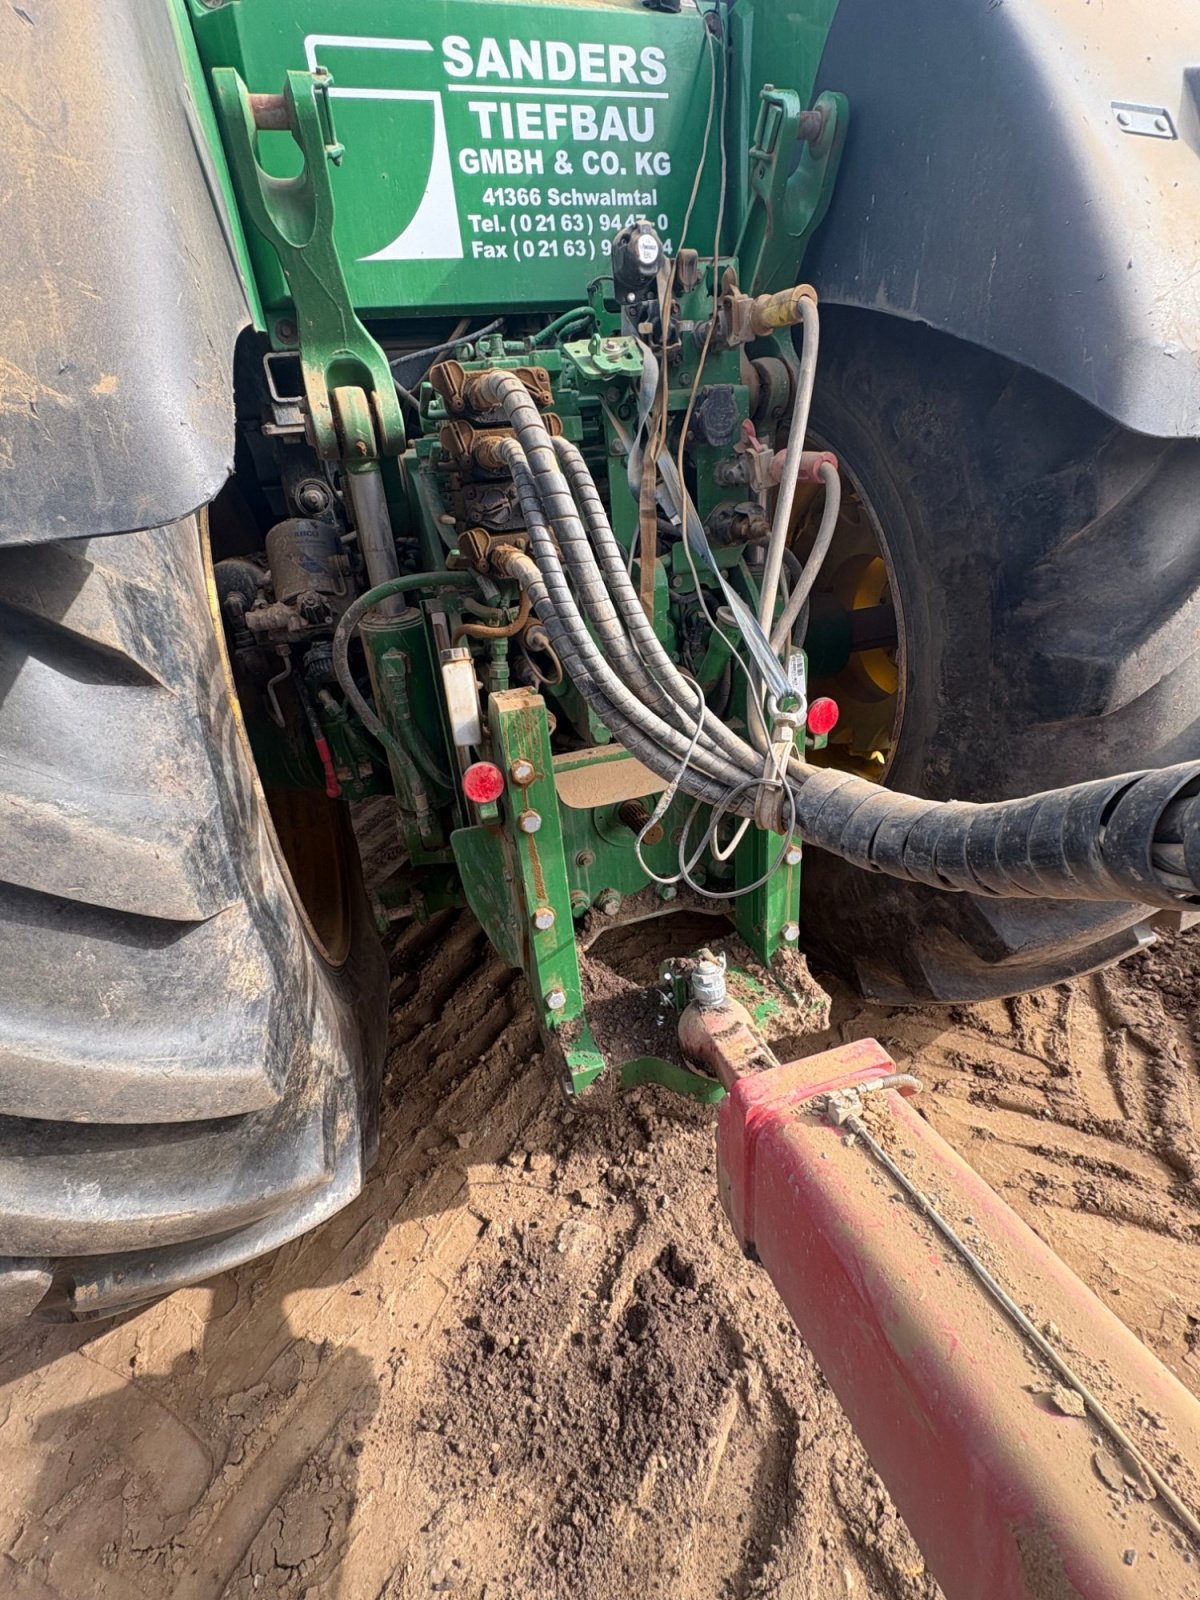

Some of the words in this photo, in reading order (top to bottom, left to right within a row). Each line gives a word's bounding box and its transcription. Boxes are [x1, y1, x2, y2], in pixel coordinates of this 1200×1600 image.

[441, 35, 667, 85] SANDERS
[467, 101, 655, 143] TIEFBAU
[458, 148, 544, 175] GMBH
[553, 149, 574, 176] &
[582, 150, 627, 176] CO.
[635, 151, 671, 176] KG
[482, 187, 542, 206] 41366
[547, 188, 658, 206] Schwalmtal
[467, 214, 506, 233] Tel.
[471, 240, 508, 259] Fax
